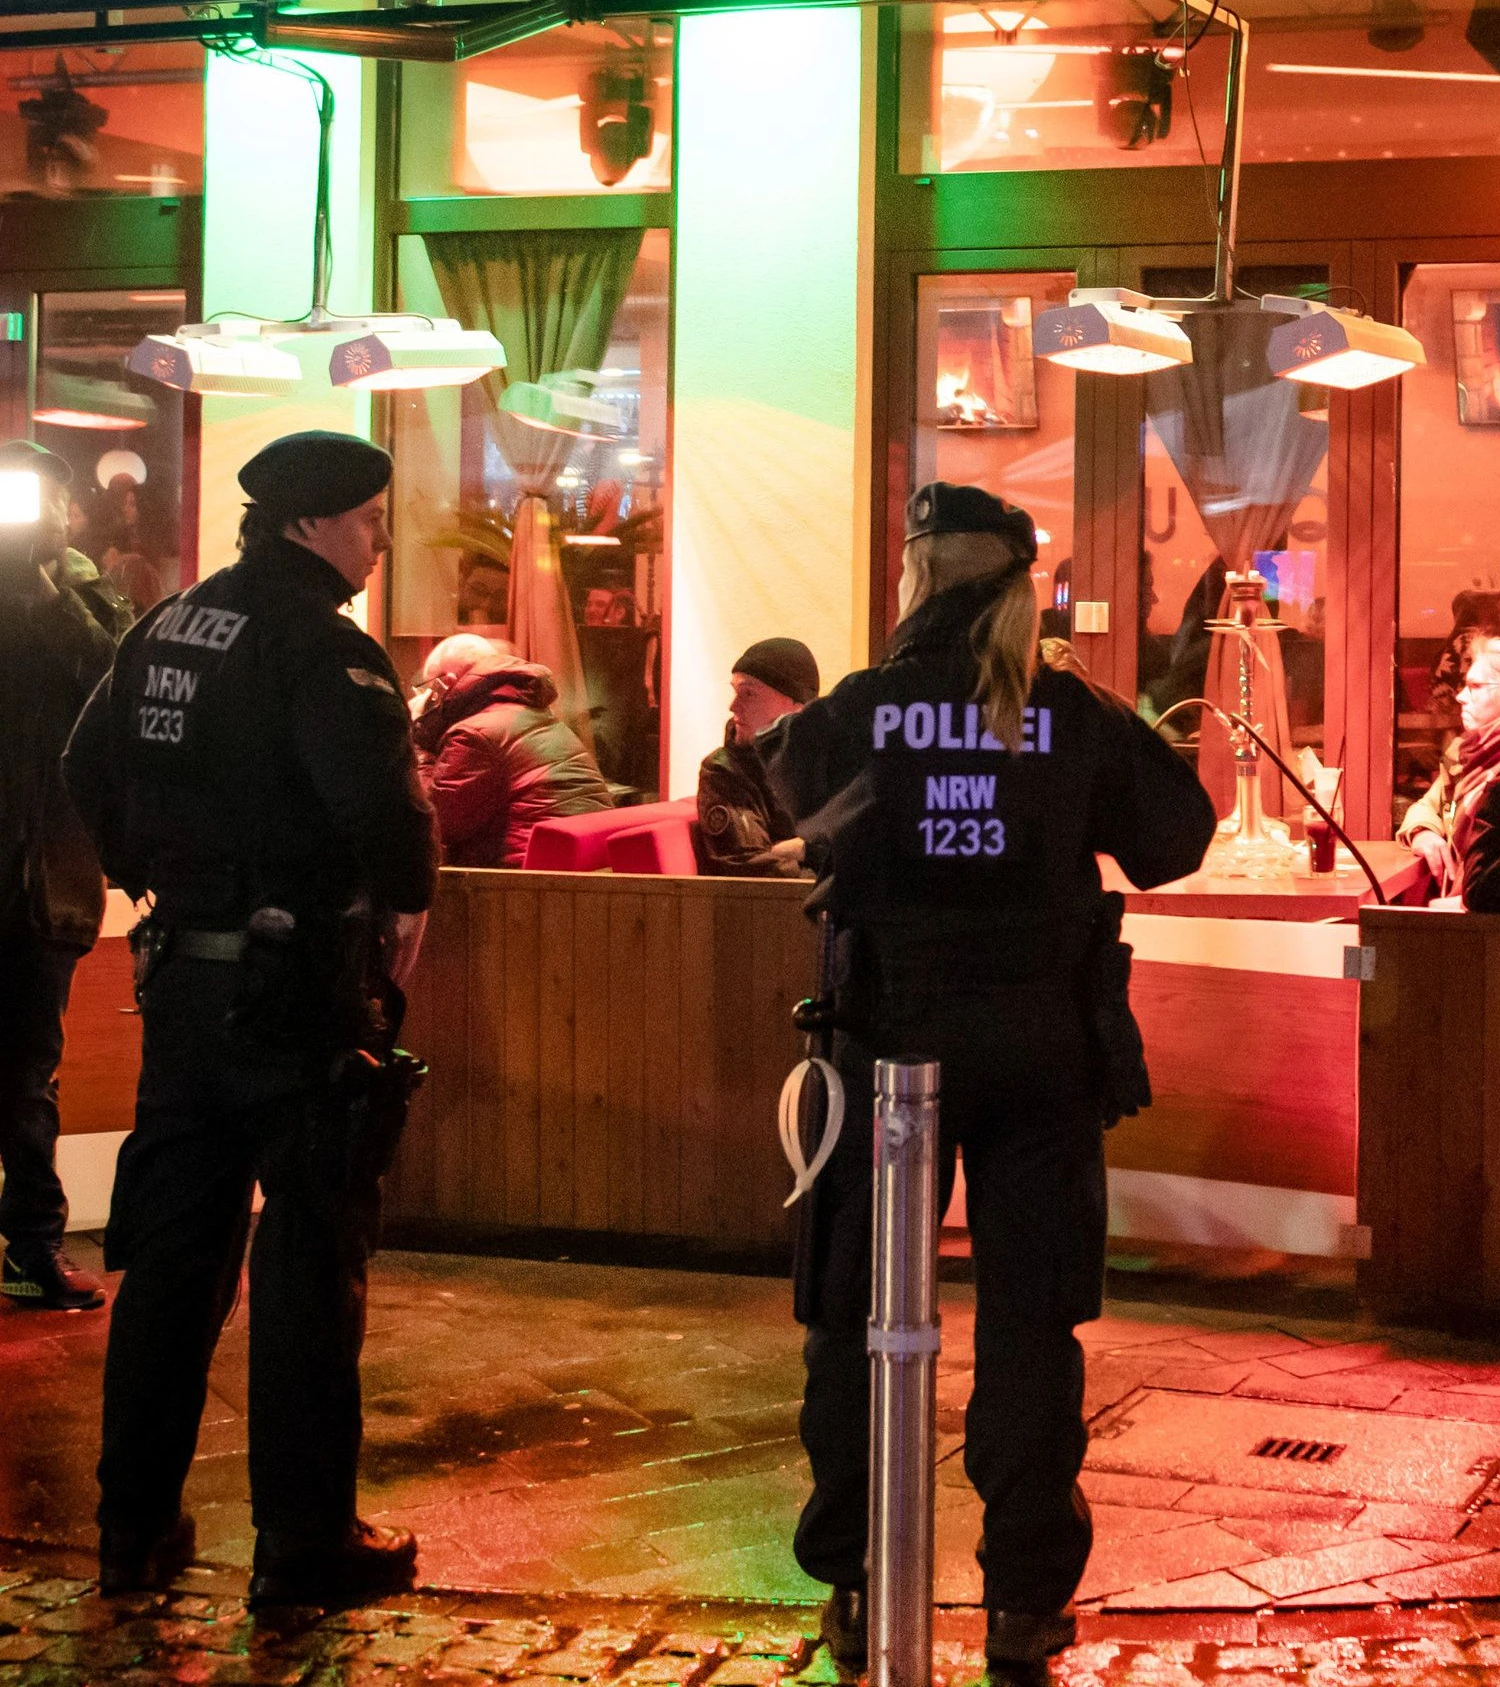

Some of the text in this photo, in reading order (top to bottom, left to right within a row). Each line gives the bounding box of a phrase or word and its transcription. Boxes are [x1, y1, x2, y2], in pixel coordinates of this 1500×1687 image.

[145, 666, 199, 702] NRW
[139, 706, 184, 743] 1233
[926, 775, 996, 810] NRW
[918, 818, 1005, 856] 1233
